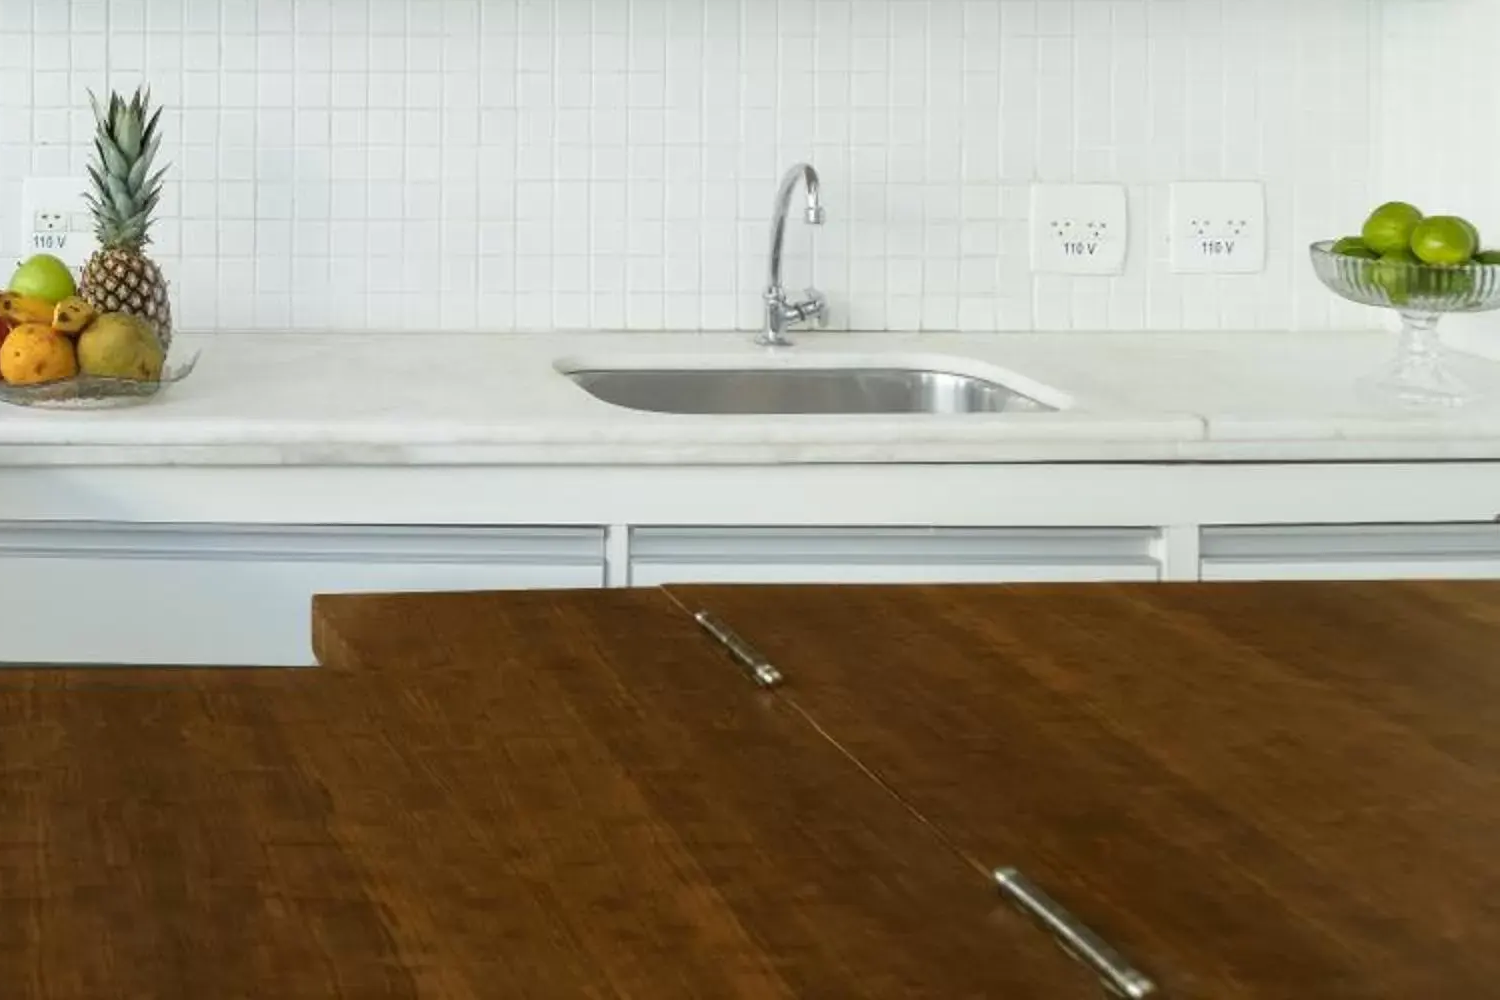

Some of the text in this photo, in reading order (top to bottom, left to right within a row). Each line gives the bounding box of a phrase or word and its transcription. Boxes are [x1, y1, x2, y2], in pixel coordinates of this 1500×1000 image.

[33, 234, 67, 249] 110 V
[1064, 242, 1098, 256] 110 V
[1202, 241, 1235, 256] 110 V
